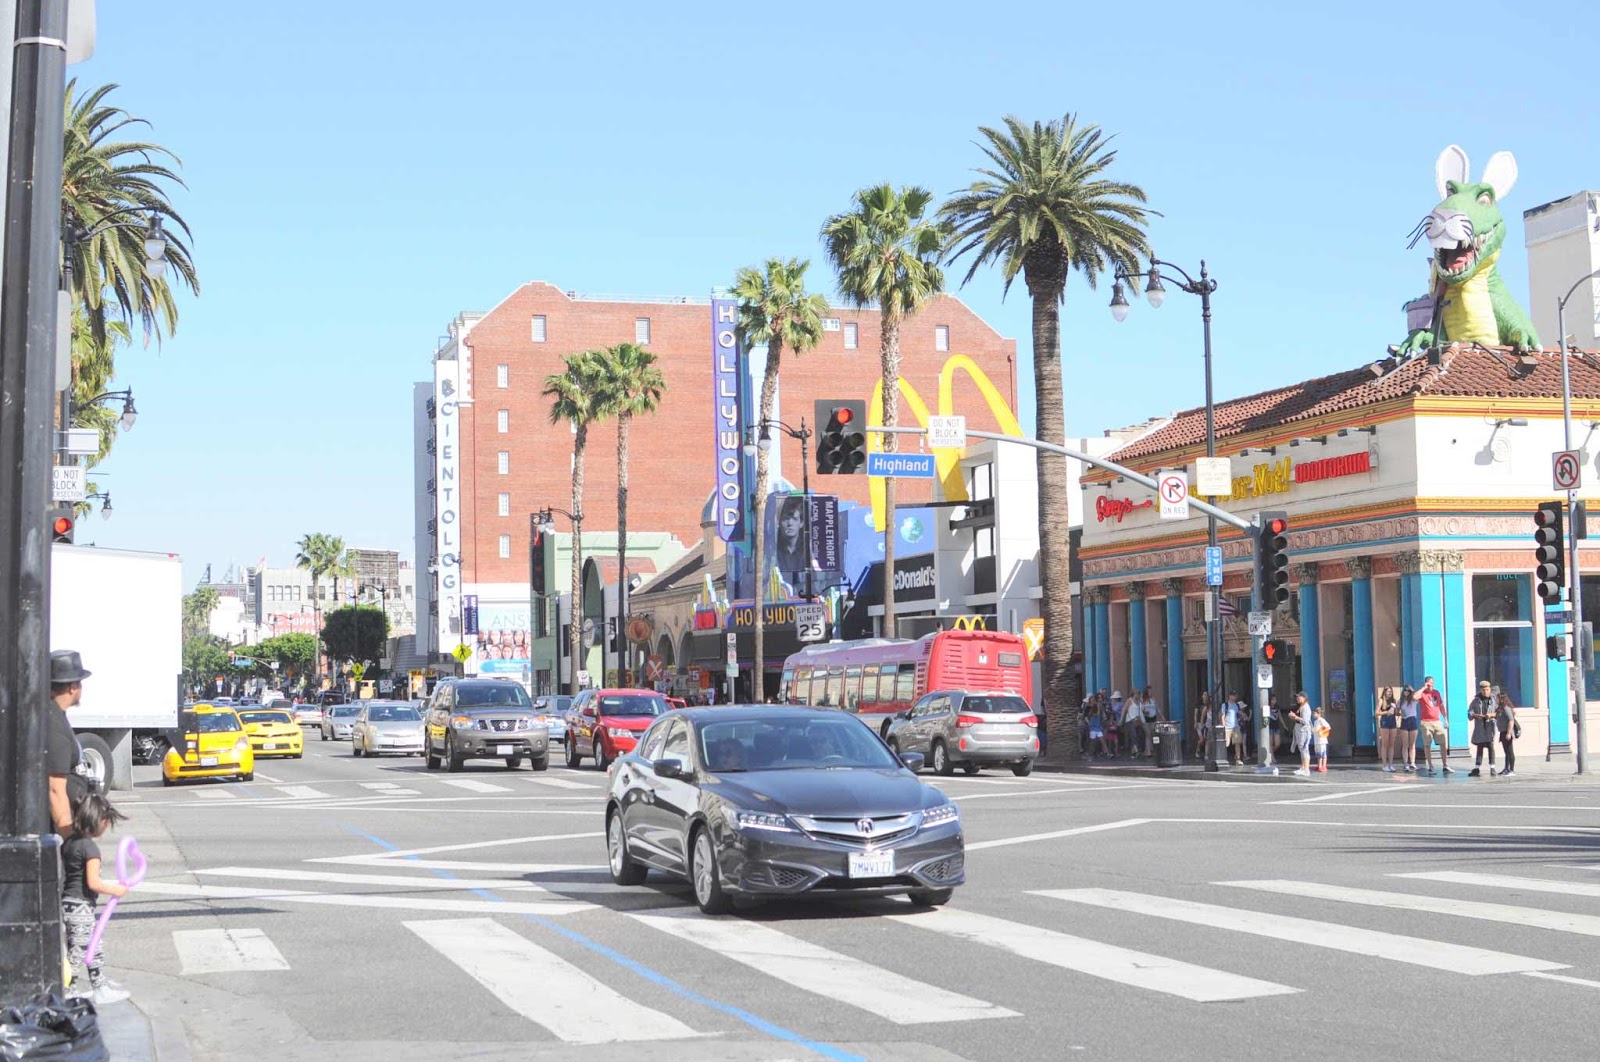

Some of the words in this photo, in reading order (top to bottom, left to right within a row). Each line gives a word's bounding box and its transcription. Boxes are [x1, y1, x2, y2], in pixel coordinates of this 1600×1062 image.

[718, 305, 740, 526] HOLLYWOOD
[933, 419, 943, 428] DO
[946, 419, 960, 428] NOT
[935, 429, 959, 438] BLOCK
[874, 458, 929, 474] Highland
[64, 470, 79, 479] NOT
[1231, 477, 1251, 500] or
[1252, 455, 1292, 497] Not!
[1295, 451, 1371, 484] ODDITORIUM
[440, 379, 457, 613] CIENTOLOG
[1163, 506, 1172, 515] ON
[1174, 506, 1186, 514] RED
[825, 501, 836, 567] MAPPLETHORPE
[1213, 549, 1221, 583] SYNC
[893, 566, 936, 591] cDonald's
[797, 607, 822, 615] SPEED
[799, 624, 822, 637] 25
